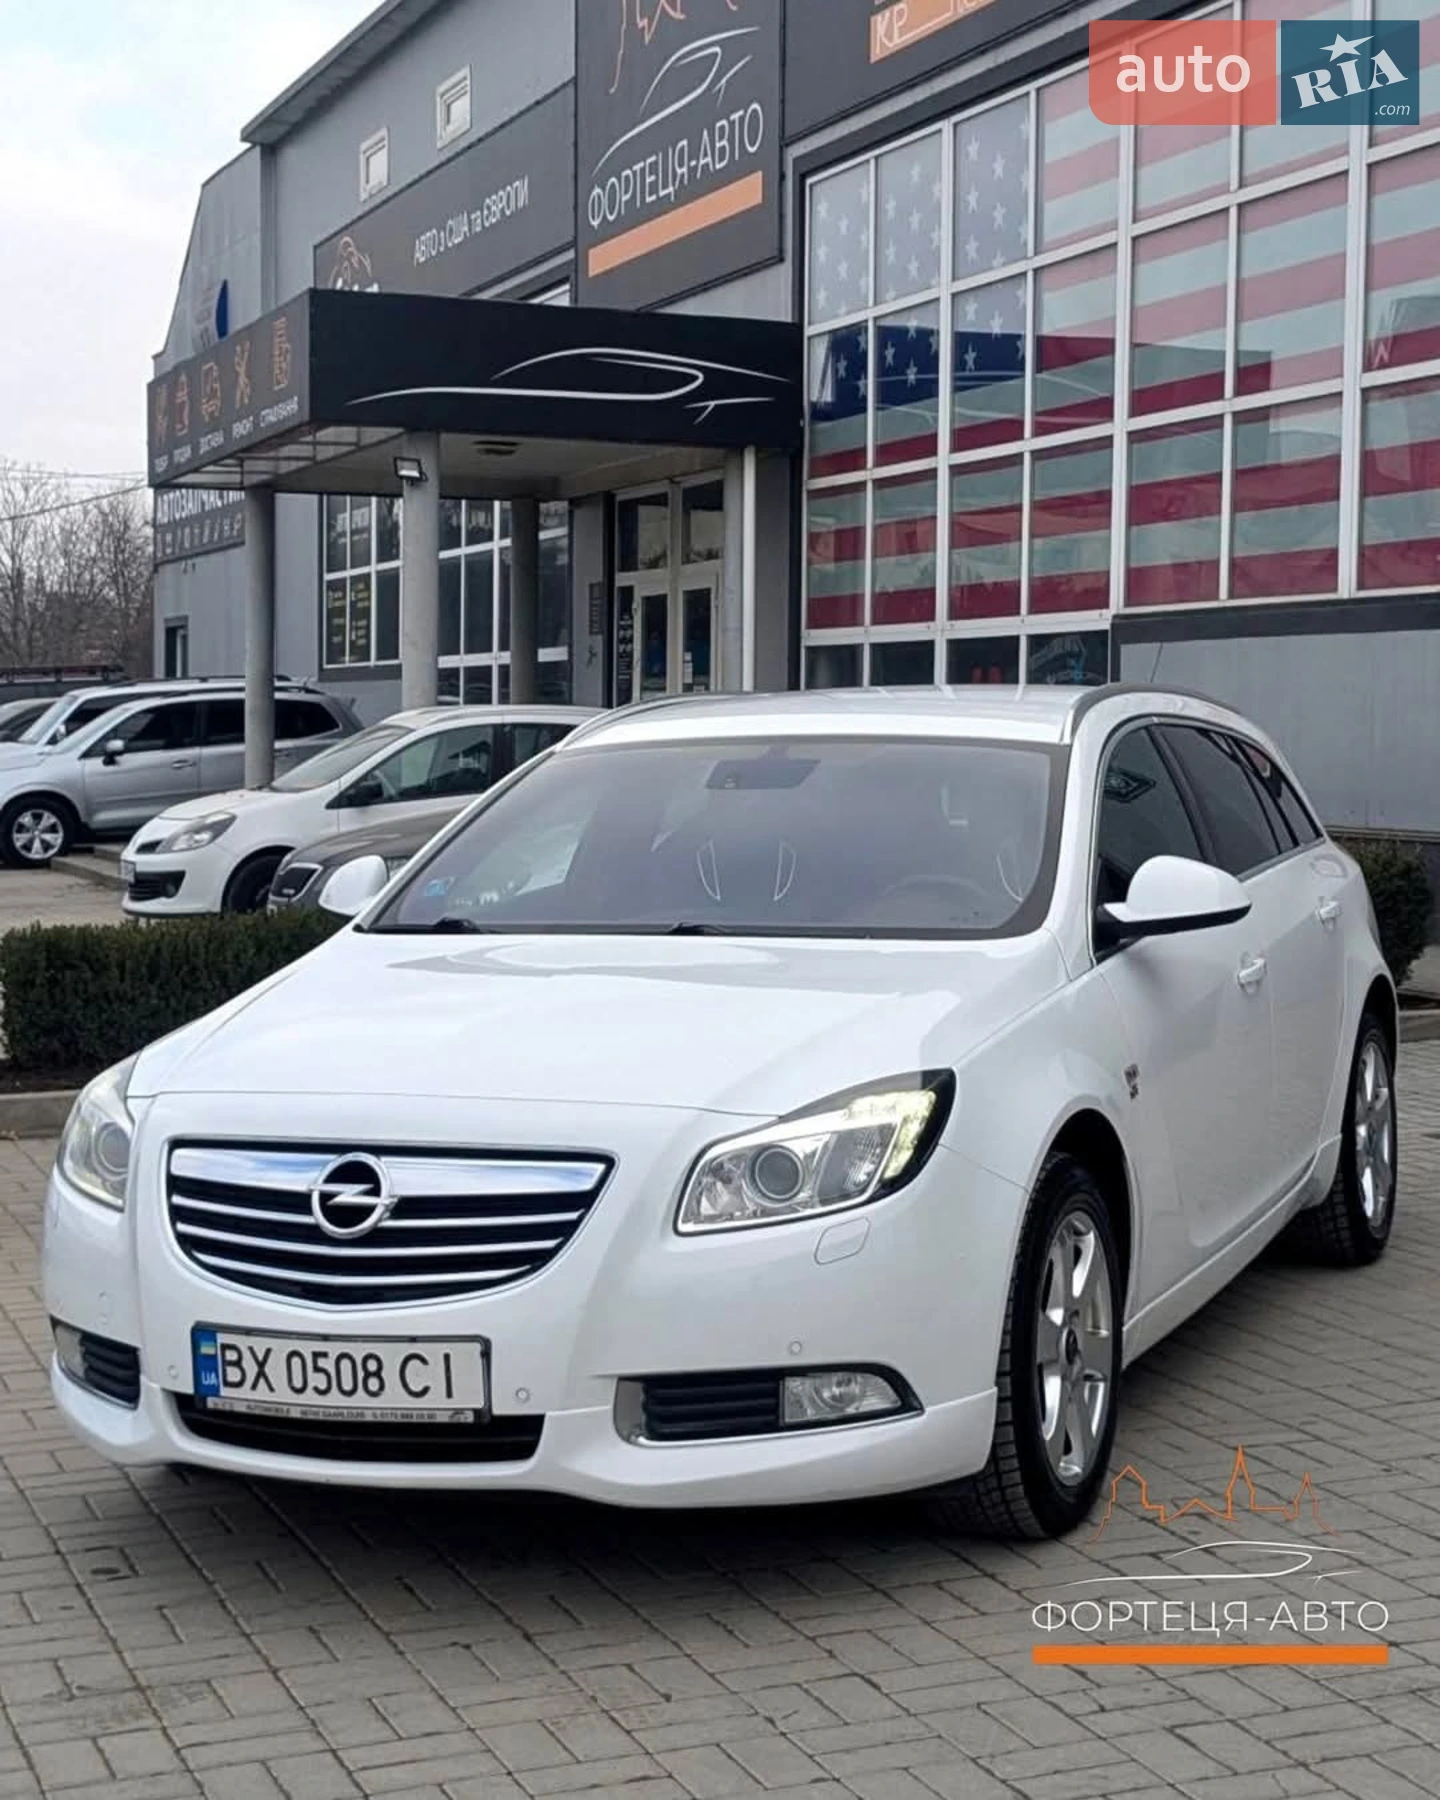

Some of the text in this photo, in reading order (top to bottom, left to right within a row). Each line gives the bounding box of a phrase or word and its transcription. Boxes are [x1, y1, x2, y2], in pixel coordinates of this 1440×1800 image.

[588, 103, 763, 229] ФОРТЕЦЯ-АВТО
[414, 228, 438, 267] АВТО
[446, 210, 470, 248] США
[470, 209, 482, 234] та
[483, 174, 528, 227] ЄВРОПИ
[201, 1342, 454, 1399] UA BX 0508 CI
